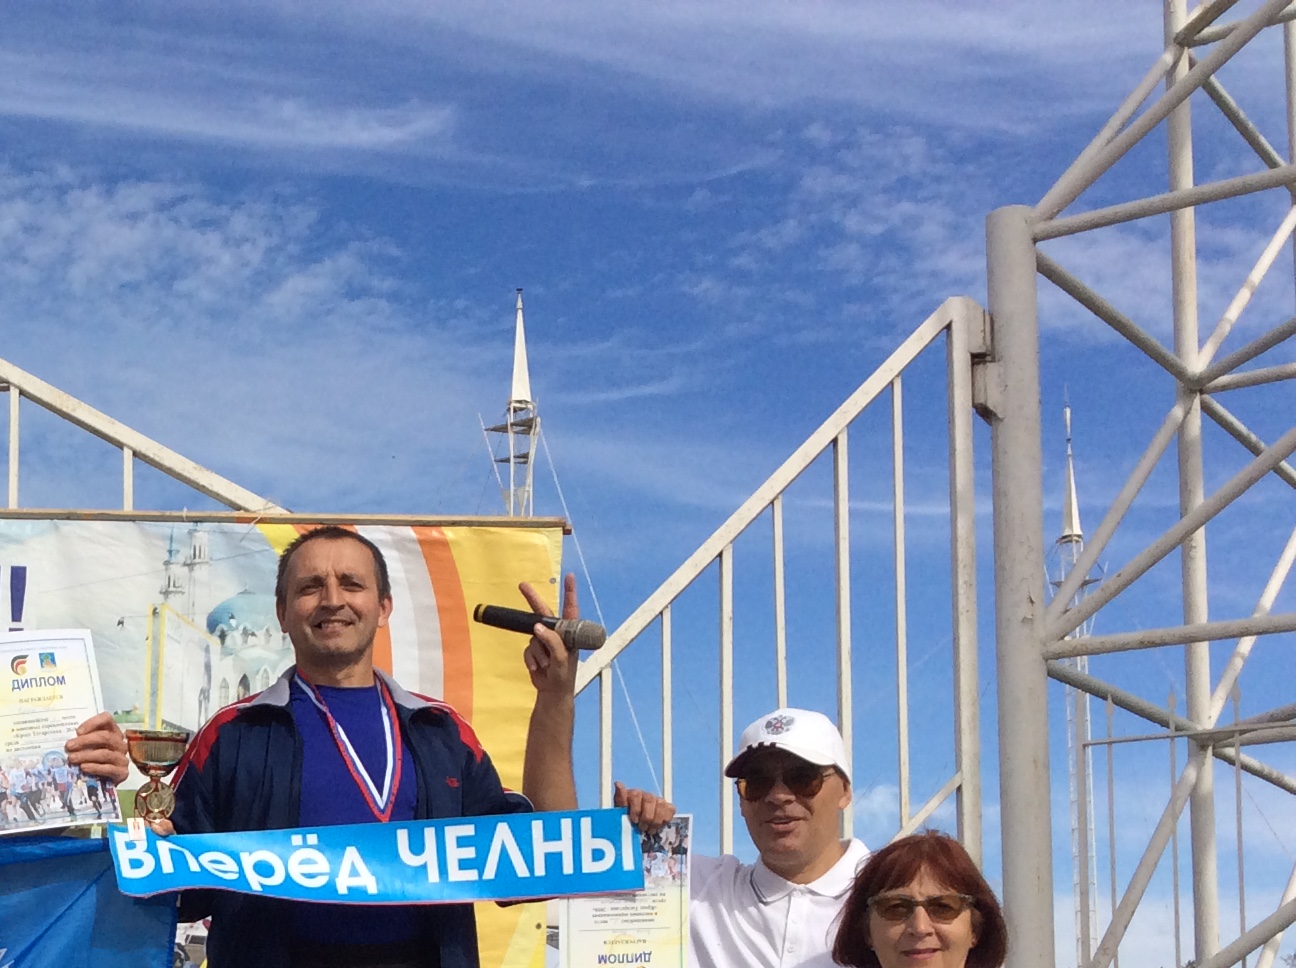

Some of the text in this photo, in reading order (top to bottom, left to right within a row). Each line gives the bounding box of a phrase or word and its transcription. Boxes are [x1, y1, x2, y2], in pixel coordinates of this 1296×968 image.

[11, 675, 67, 692] ДИПЛОМ
[115, 813, 636, 895] Вперёд ЧЕЛНЫ
[597, 950, 653, 965] ДИПЛОМ
